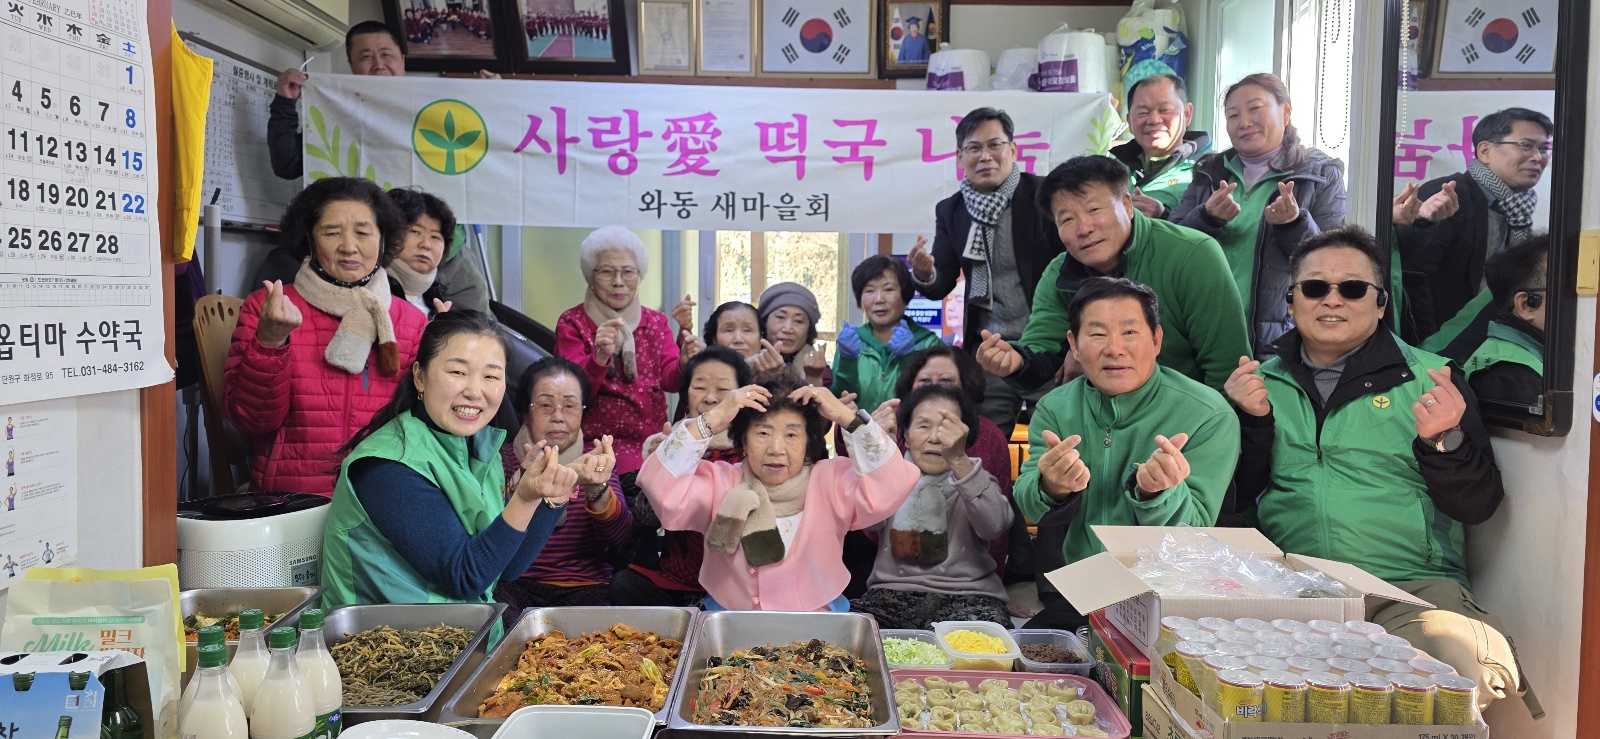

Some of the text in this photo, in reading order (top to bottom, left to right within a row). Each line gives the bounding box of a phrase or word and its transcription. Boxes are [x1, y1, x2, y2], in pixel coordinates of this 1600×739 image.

[8, 2, 24, 17] 火
[10, 14, 22, 23] TUE
[37, 12, 53, 27] 水
[66, 23, 83, 36] 木
[68, 34, 81, 43] THU
[95, 33, 112, 46] 金
[122, 42, 136, 54] 土
[125, 65, 133, 85] 1
[233, 65, 255, 83] 월중행사
[256, 74, 262, 86] 및
[11, 80, 23, 102] 4
[40, 87, 52, 109] 5
[69, 95, 81, 116] 6
[98, 101, 110, 121] 7
[125, 108, 136, 128] 8
[8, 127, 28, 152] 11
[36, 134, 59, 158] 12
[512, 106, 724, 178] 사랑愛
[754, 111, 888, 181] 떡국
[64, 140, 88, 163] 13
[94, 145, 117, 167] 14
[122, 150, 143, 171] 15
[8, 178, 30, 201] 18
[37, 182, 60, 205] 19
[65, 186, 89, 208] 20
[95, 190, 117, 211] 21
[122, 193, 145, 214] 22
[637, 188, 830, 222] 와동 새마을회
[8, 227, 32, 249] 25
[38, 229, 62, 251] 26
[67, 232, 90, 252] 27
[96, 234, 119, 254] 28
[76, 319, 143, 355] 수약국
[1, 371, 54, 385] 단원구 화정로 95
[61, 361, 145, 378] TEL.031-484-3162
[289, 554, 317, 566] SAMSUNG
[23, 631, 95, 652] Milk
[100, 629, 132, 646] 밀크
